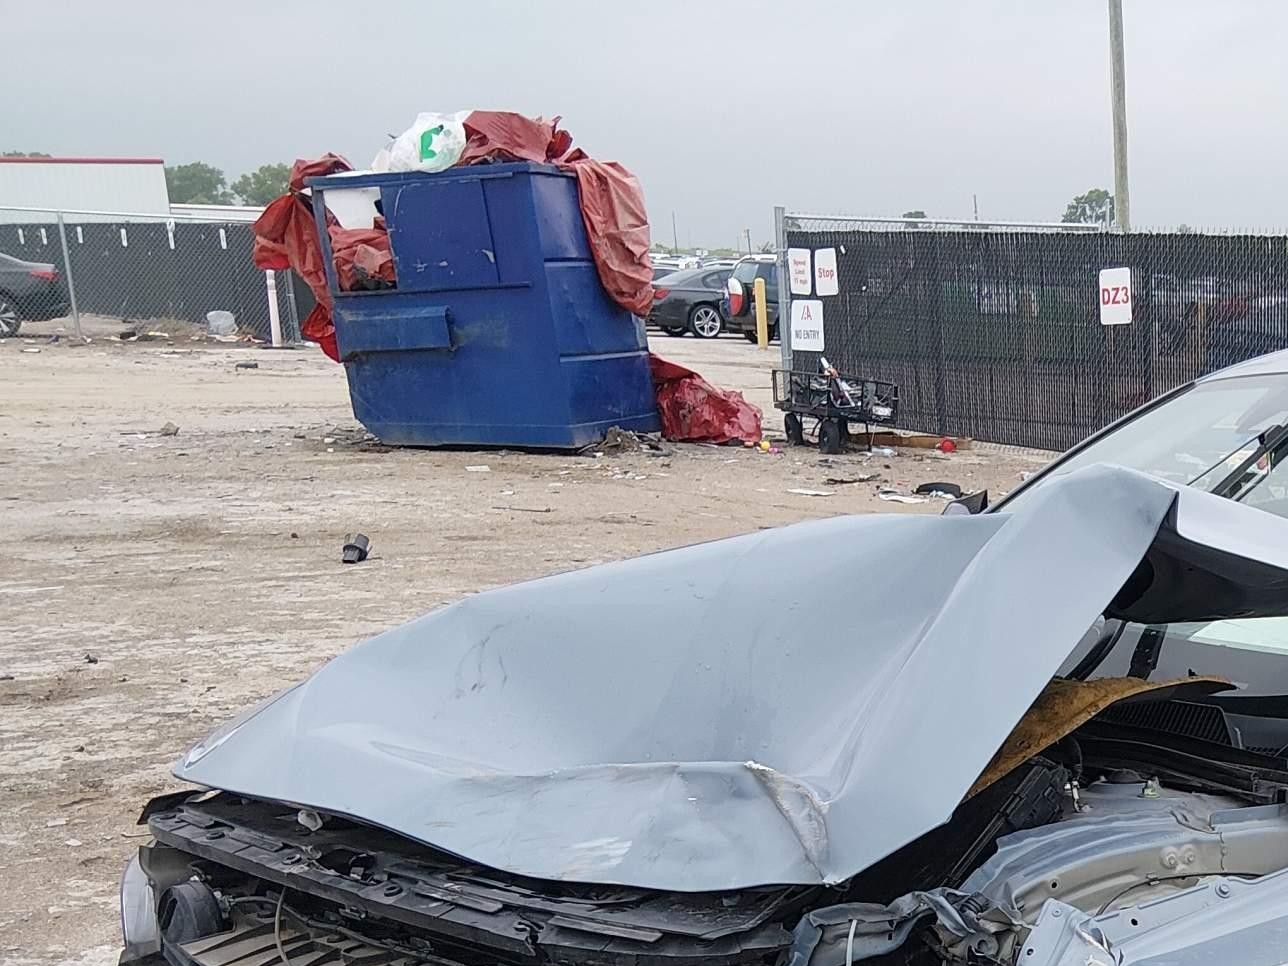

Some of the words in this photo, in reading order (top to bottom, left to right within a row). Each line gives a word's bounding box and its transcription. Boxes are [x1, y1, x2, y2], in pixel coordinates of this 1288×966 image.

[817, 267, 834, 280] Stop
[1102, 286, 1129, 305] DZ3
[795, 329, 802, 340] NO
[803, 329, 820, 340] ENTRY
